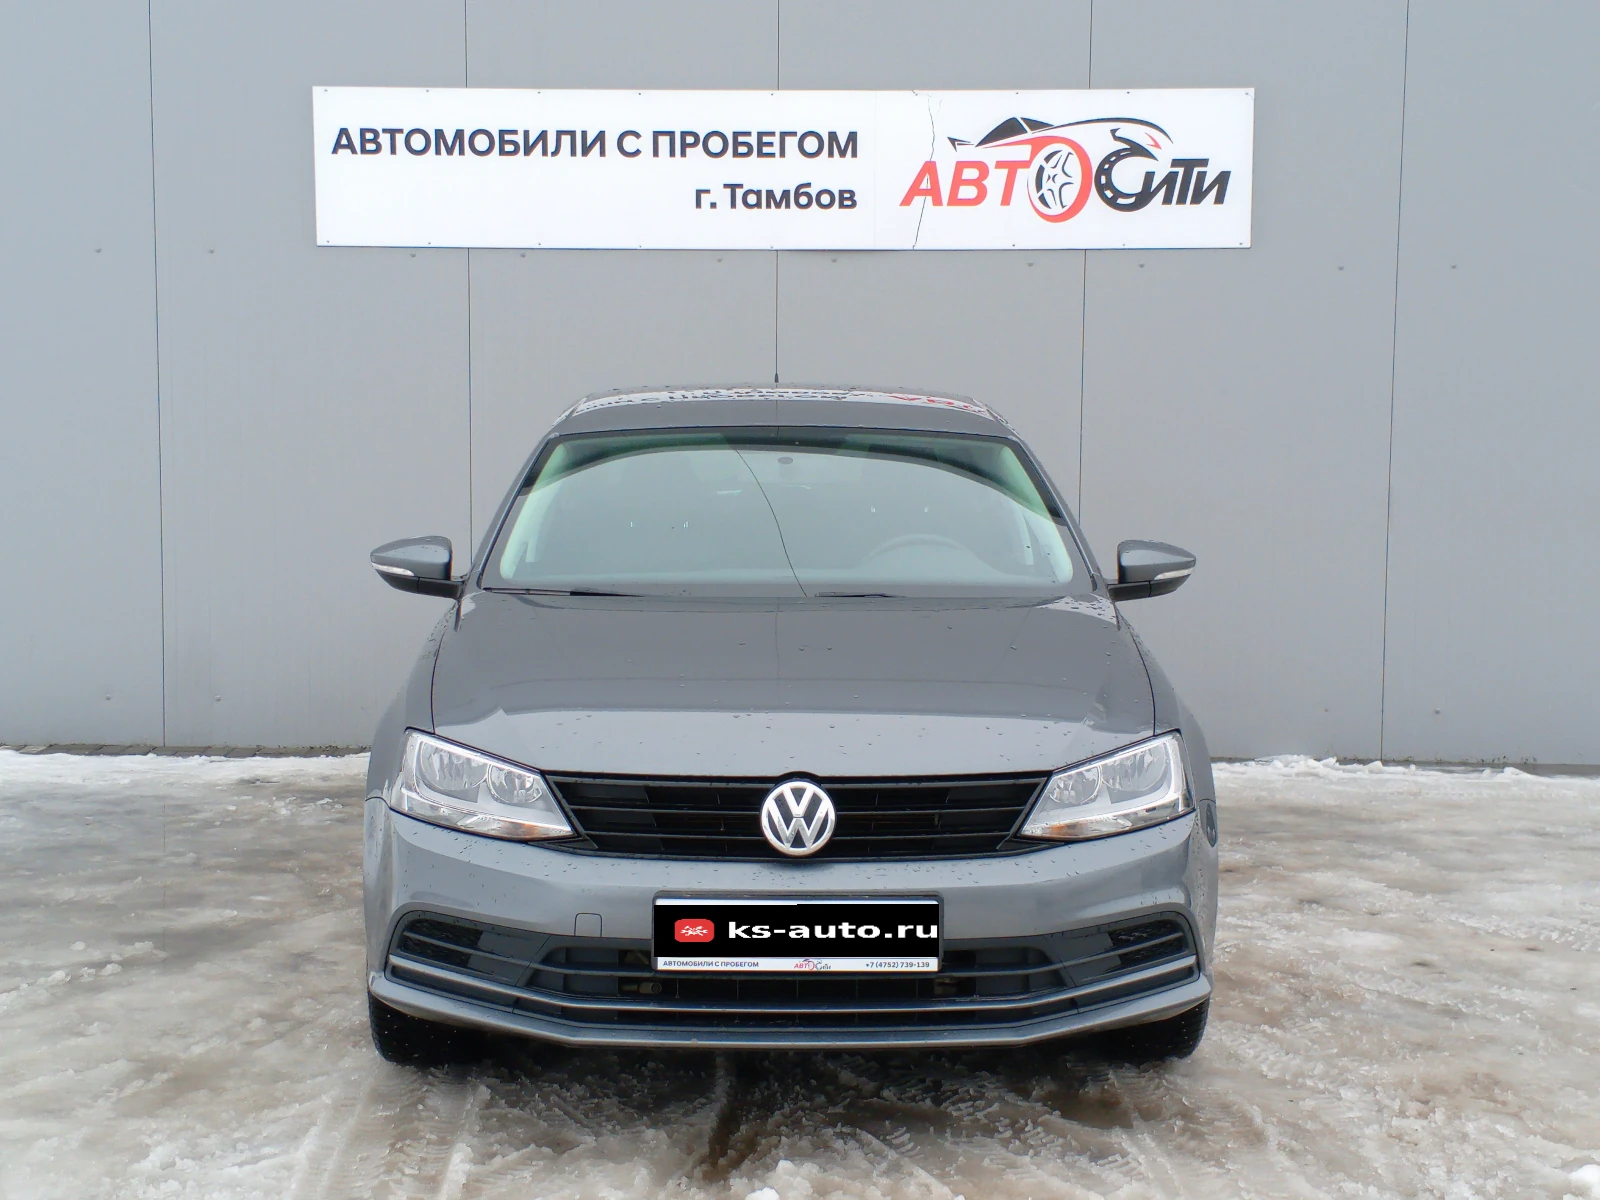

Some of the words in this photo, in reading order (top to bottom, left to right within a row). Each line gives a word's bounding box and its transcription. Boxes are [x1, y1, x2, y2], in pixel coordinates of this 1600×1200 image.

[331, 127, 606, 158] АВТОМОБИЛИ
[616, 130, 642, 158] С
[652, 130, 858, 159] ПРОБЕГОМ
[695, 187, 718, 210] г.
[723, 182, 858, 210] Тамбов
[865, 961, 875, 969] +7
[875, 960, 899, 970] (4752)
[900, 961, 930, 969] 739-139
